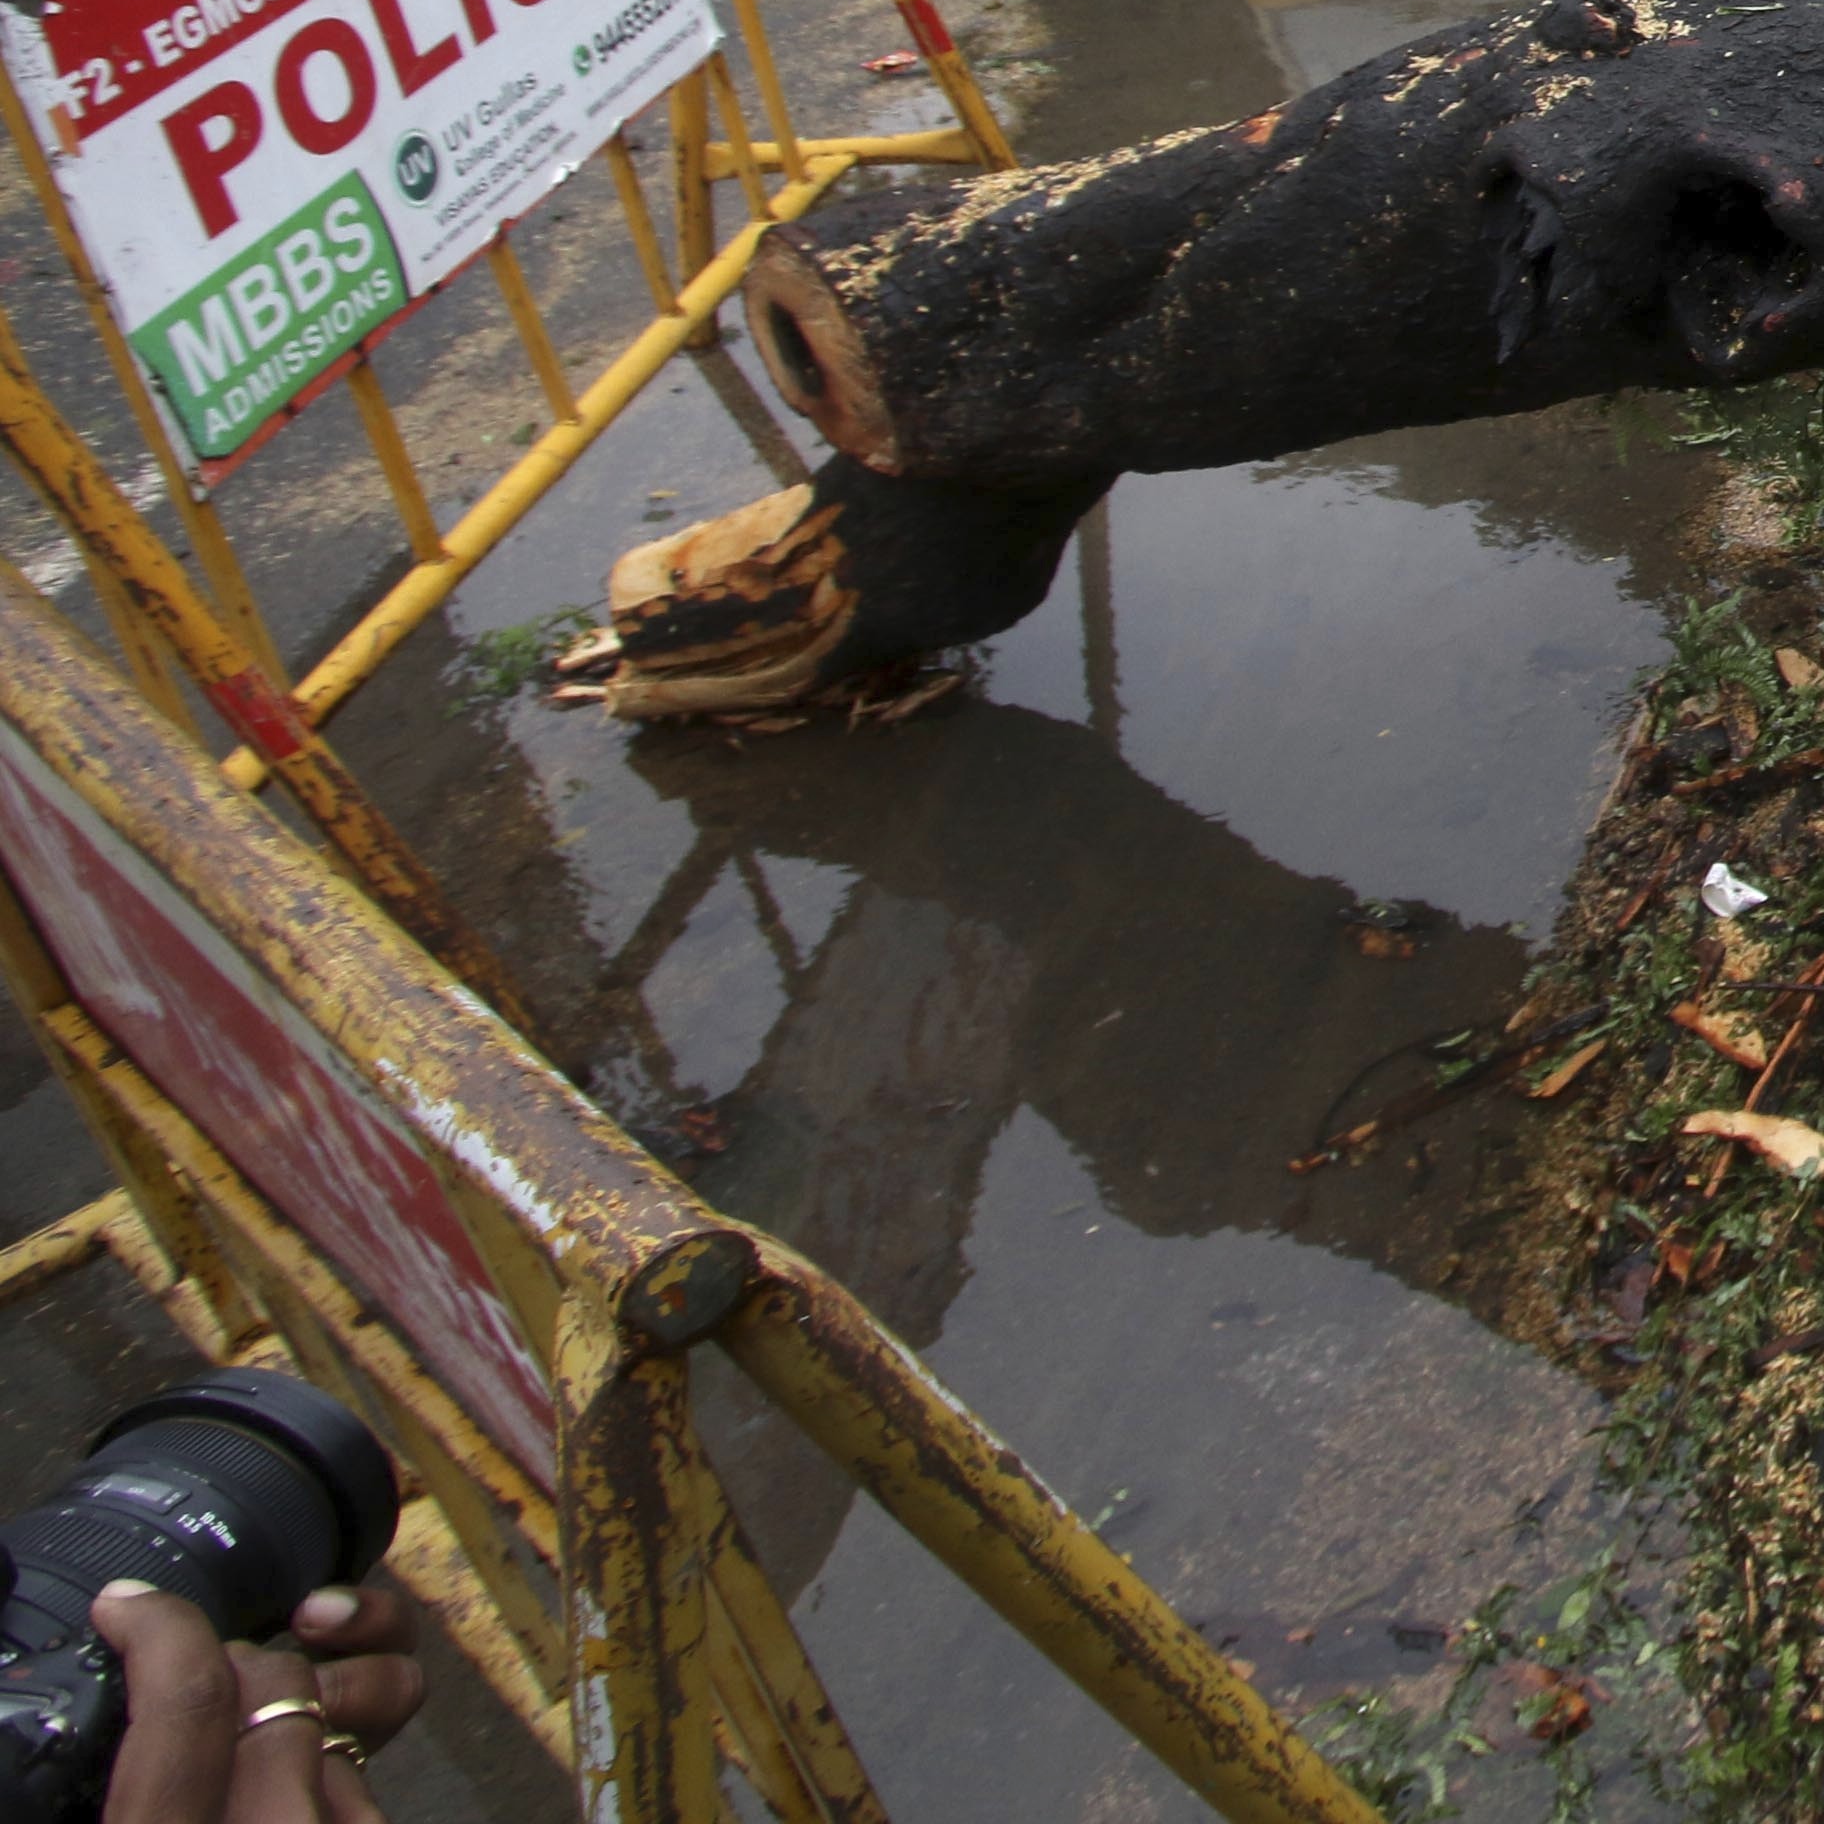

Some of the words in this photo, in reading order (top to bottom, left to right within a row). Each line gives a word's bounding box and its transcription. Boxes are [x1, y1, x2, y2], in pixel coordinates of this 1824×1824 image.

[442, 113, 473, 152] UV
[166, 196, 374, 397] MBBS
[203, 267, 393, 445] ADMISSIONS
